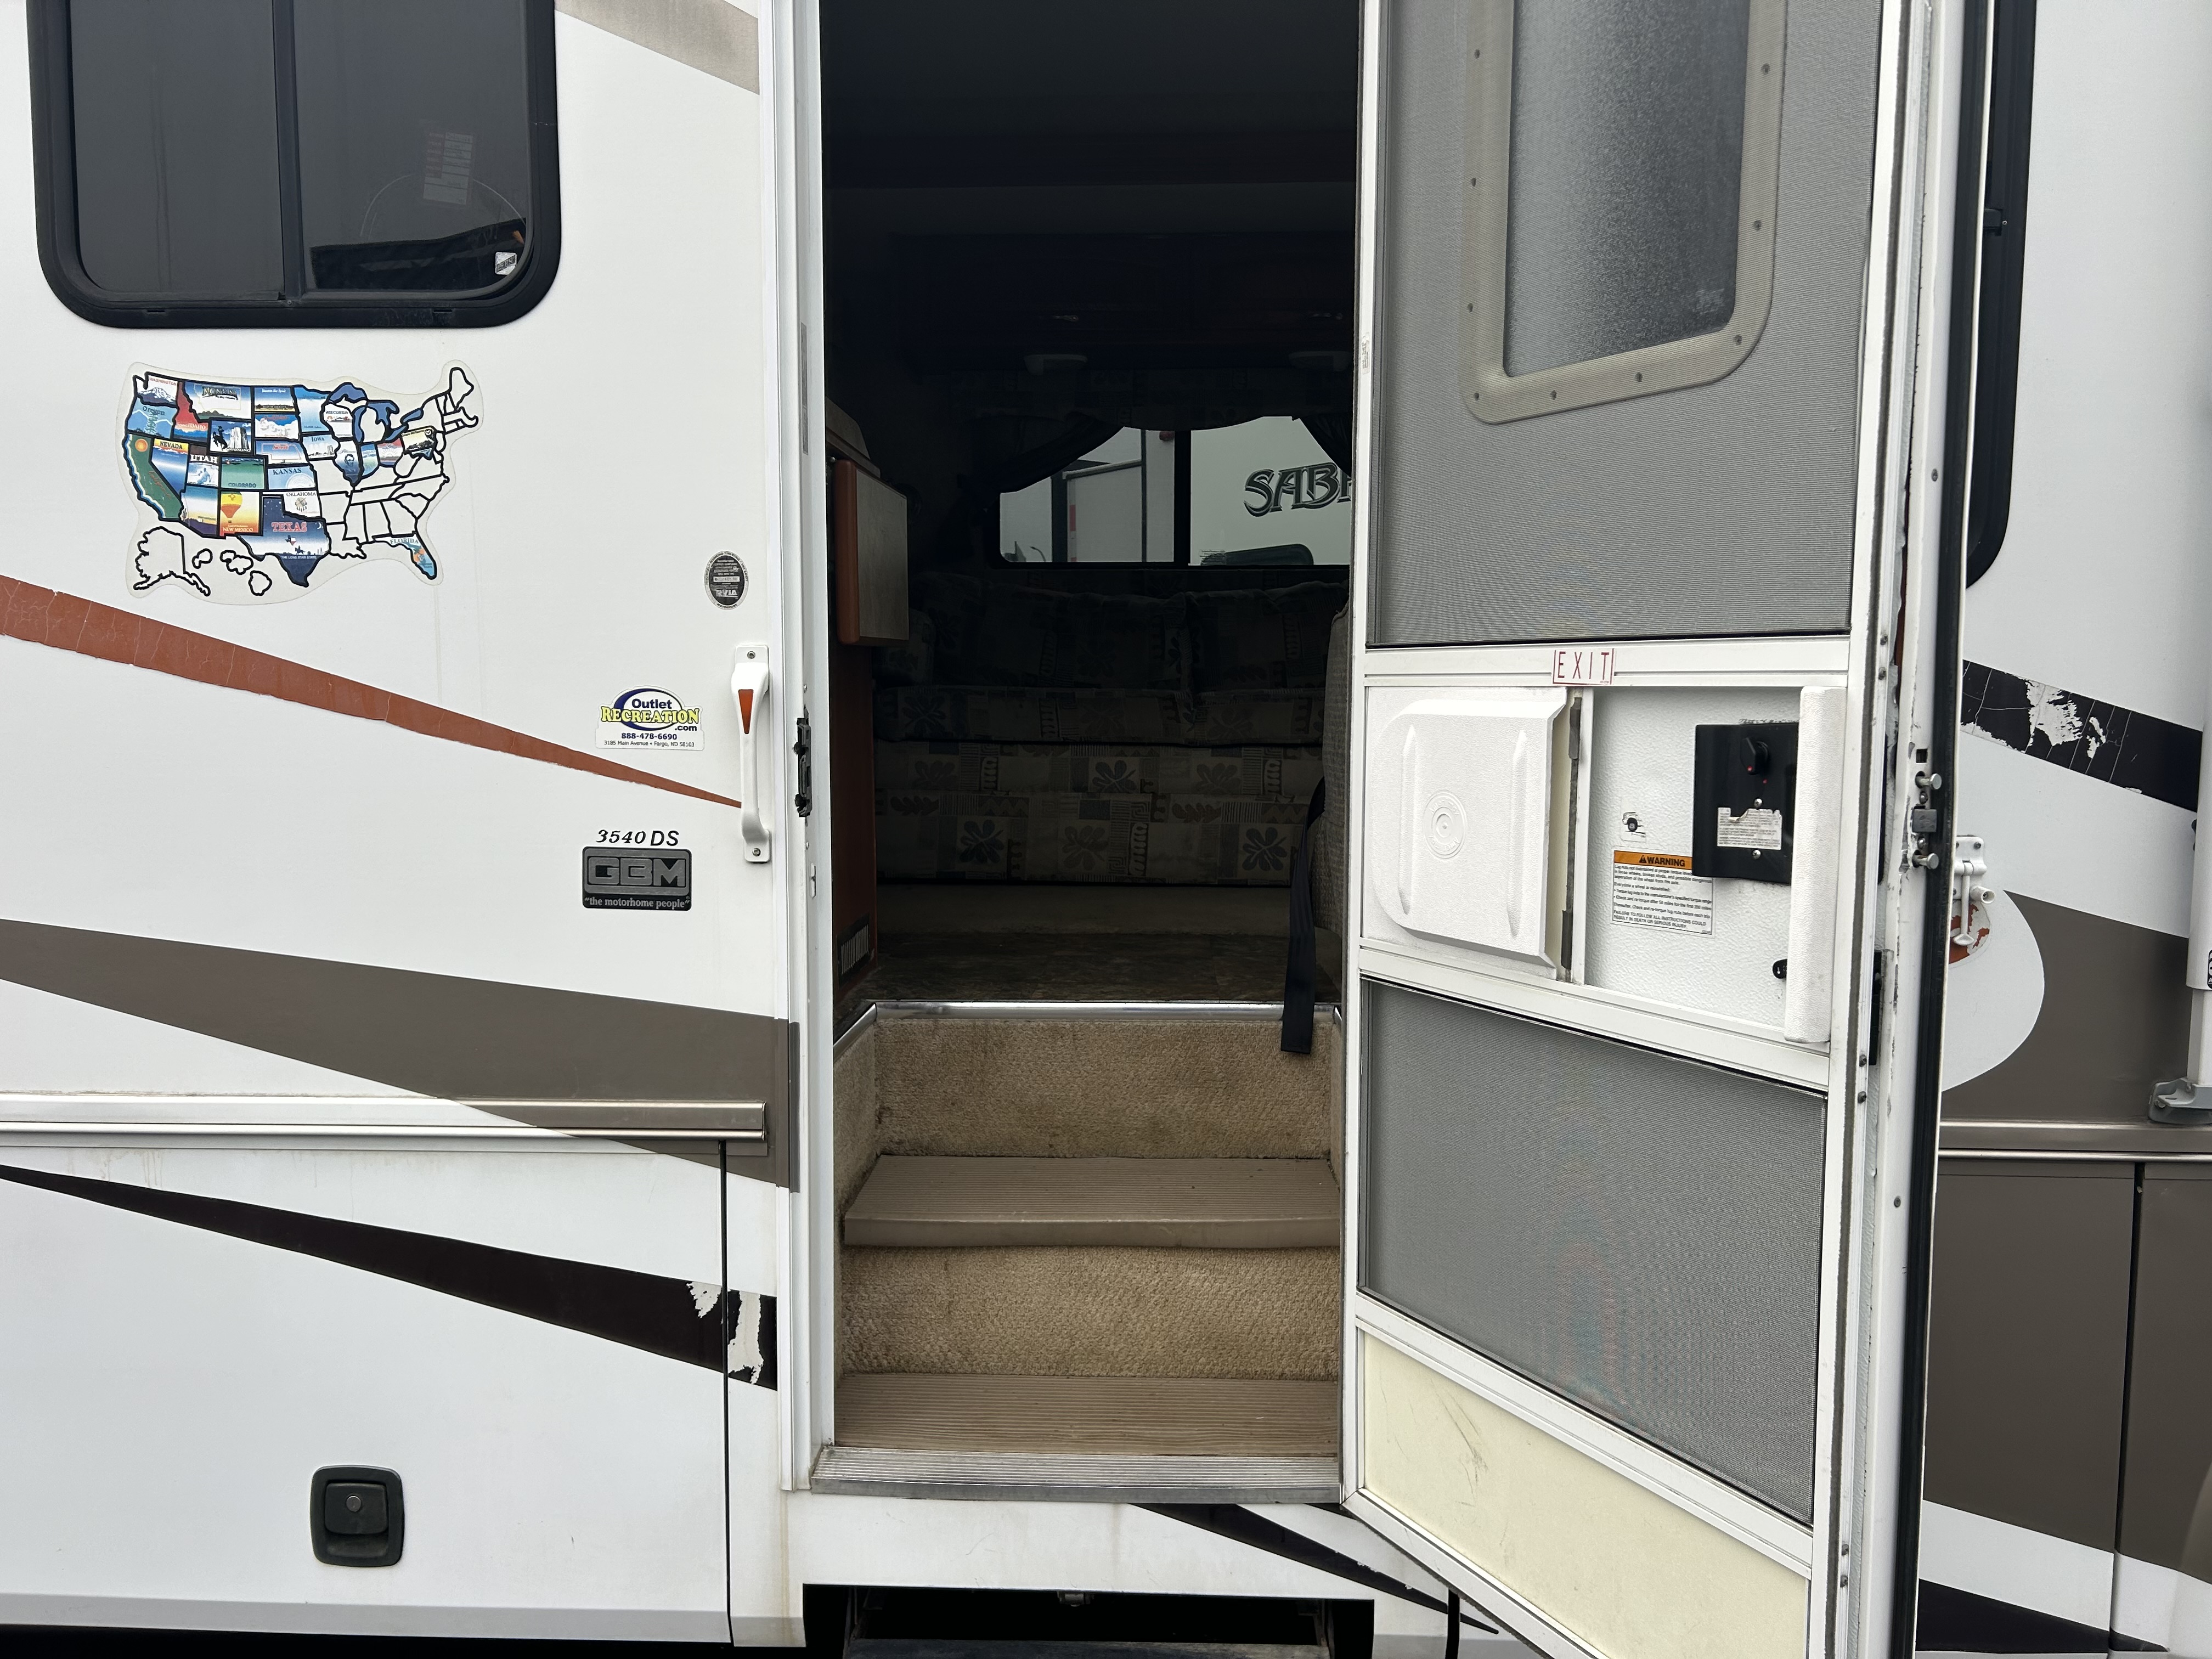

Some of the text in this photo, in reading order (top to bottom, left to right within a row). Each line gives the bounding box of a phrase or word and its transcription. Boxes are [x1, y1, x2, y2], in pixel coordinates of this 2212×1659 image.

[142, 406, 165, 416] Oregon
[160, 441, 183, 450] NEVADA
[190, 454, 218, 464] UTAH
[271, 522, 307, 532] TEXAS
[1558, 651, 1610, 680] EXIT
[631, 698, 672, 709] Outlet
[600, 706, 699, 724] RECREATION
[596, 830, 680, 846] 3540 DS
[1647, 856, 1685, 867] WARNING
[605, 898, 654, 907] motorhome
